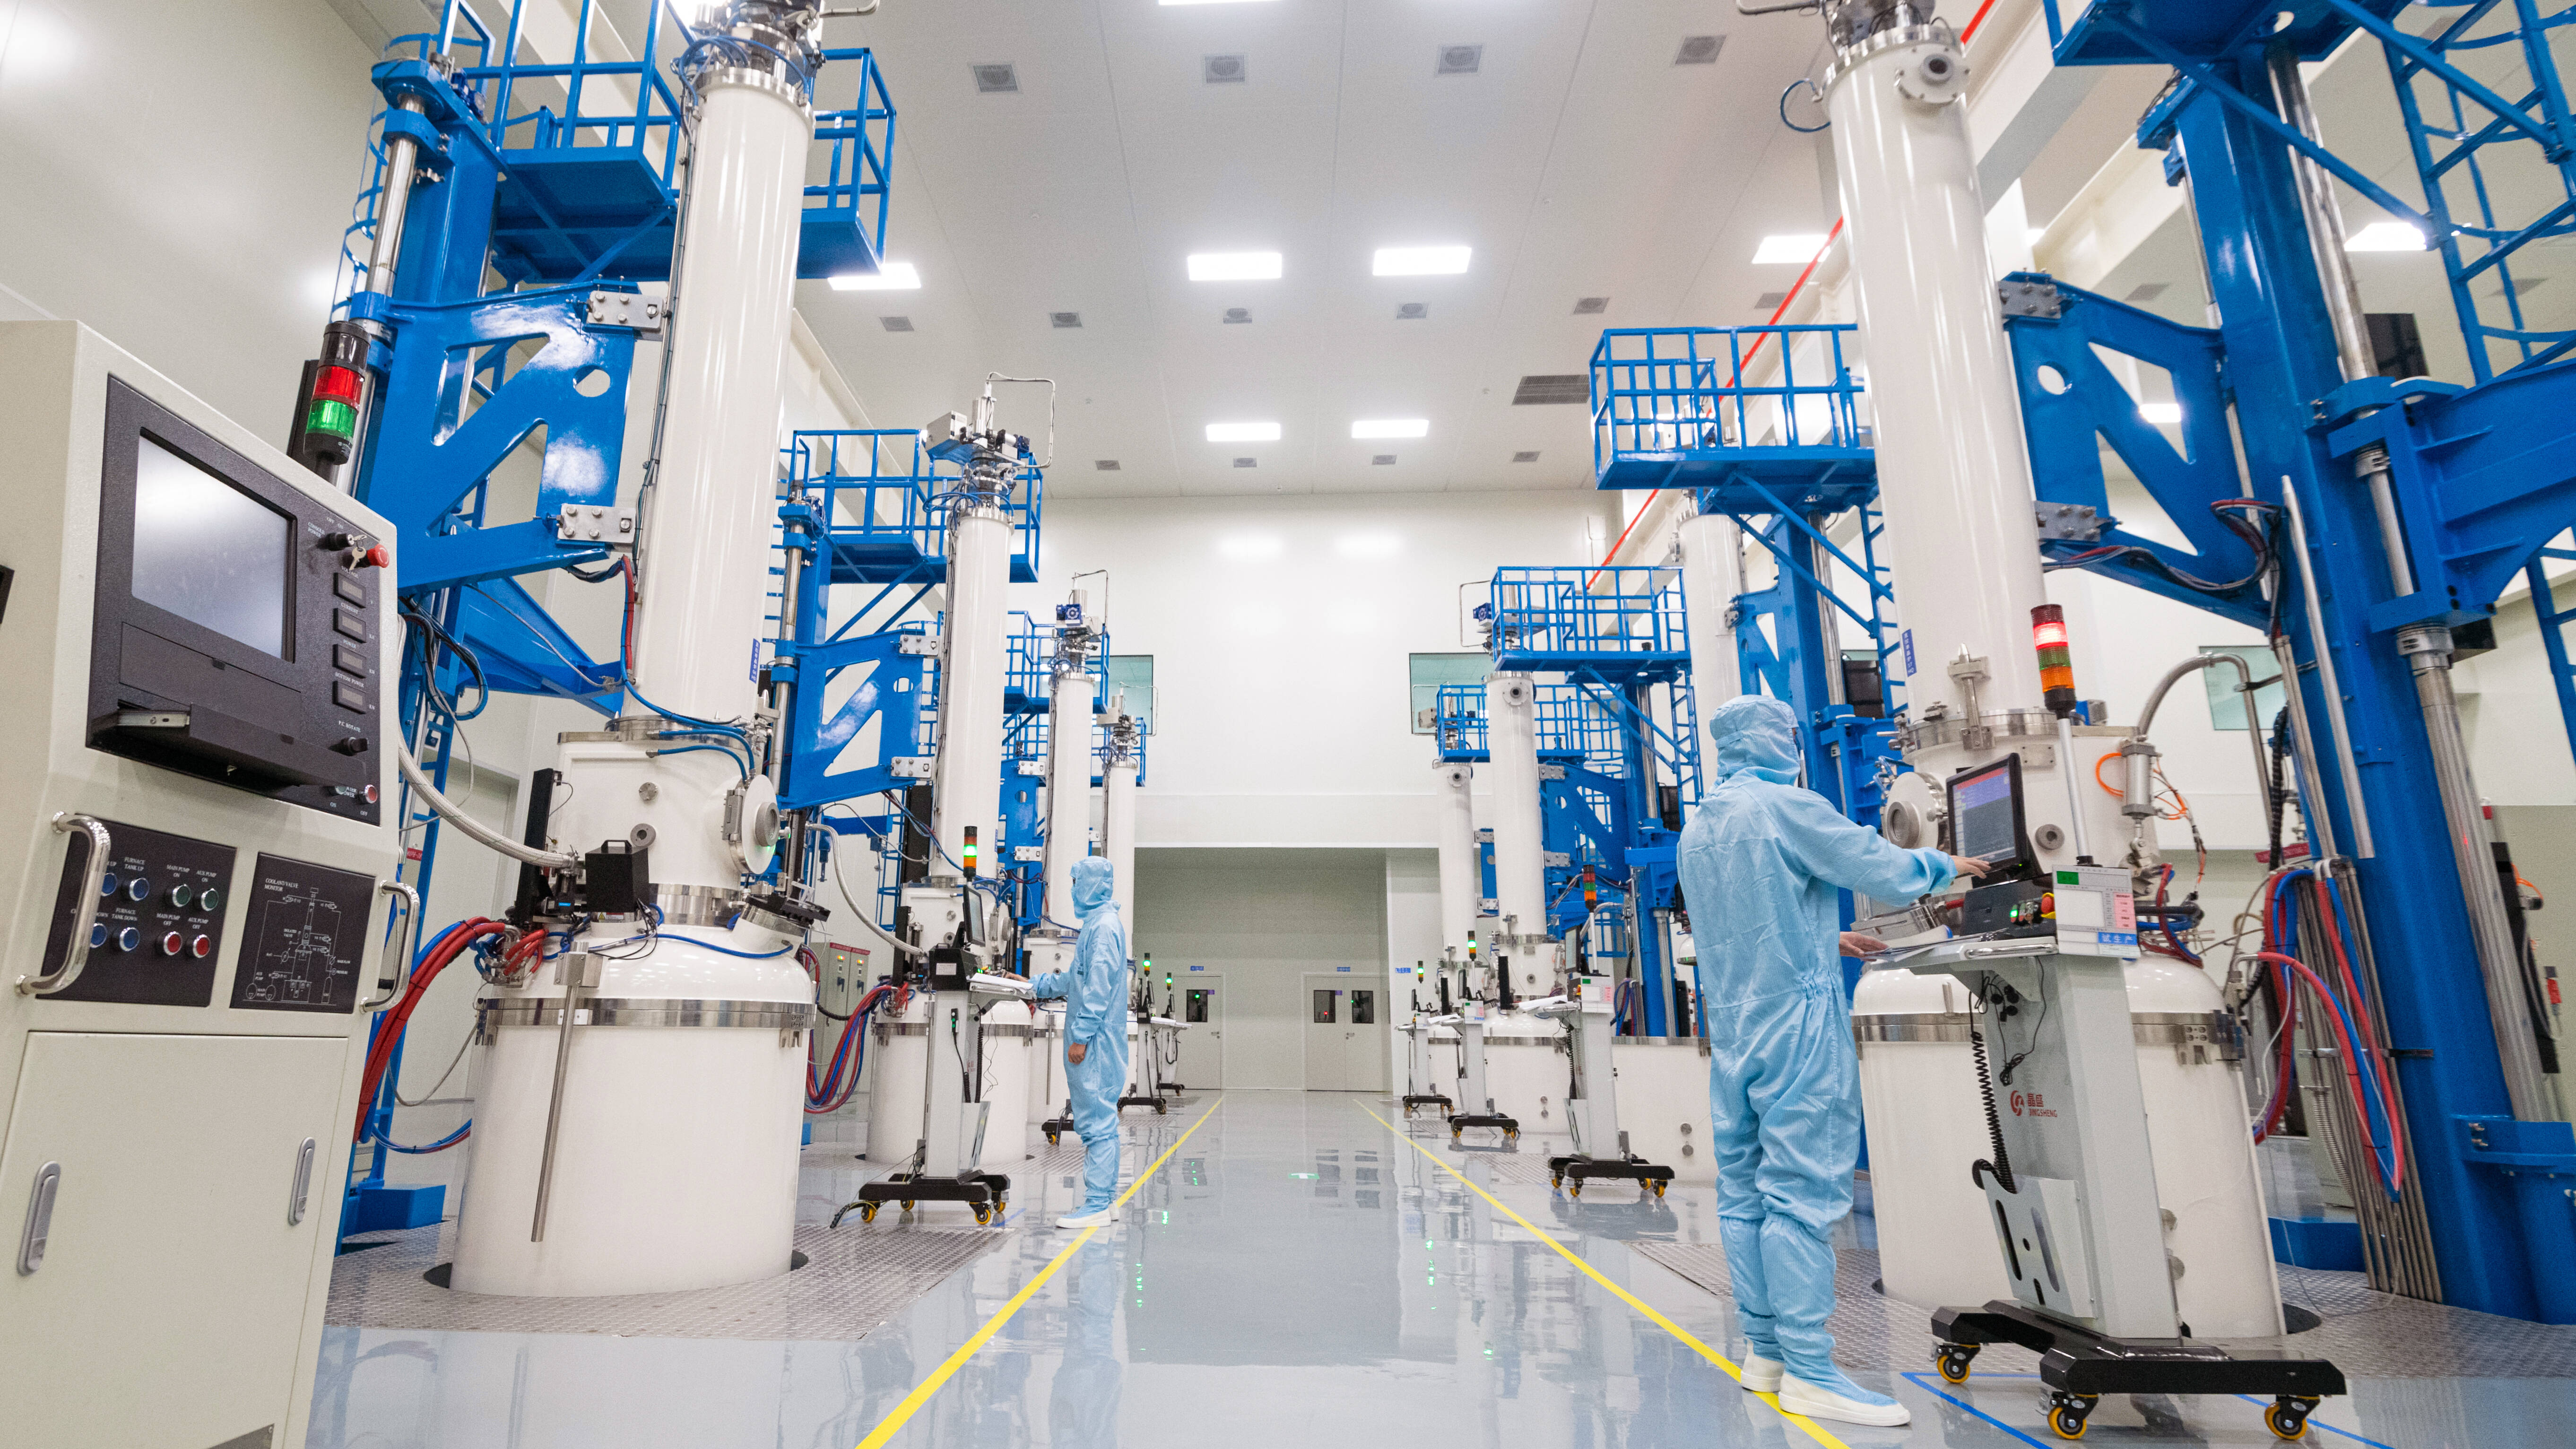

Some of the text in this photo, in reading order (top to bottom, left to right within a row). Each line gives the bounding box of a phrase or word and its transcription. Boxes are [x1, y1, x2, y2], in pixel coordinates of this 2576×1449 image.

[308, 522, 325, 535] CONSOLE
[308, 527, 321, 538] POWER
[341, 602, 358, 614] CURRENT
[343, 639, 356, 648] POWER
[335, 671, 364, 688] BOTTOM POWER
[346, 723, 361, 733] ROTATE
[124, 857, 145, 865] FURNACE
[2101, 933, 2133, 944] 试生产
[2027, 1093, 2044, 1107] 晶盛
[2029, 1108, 2058, 1118] JINGSHENG
